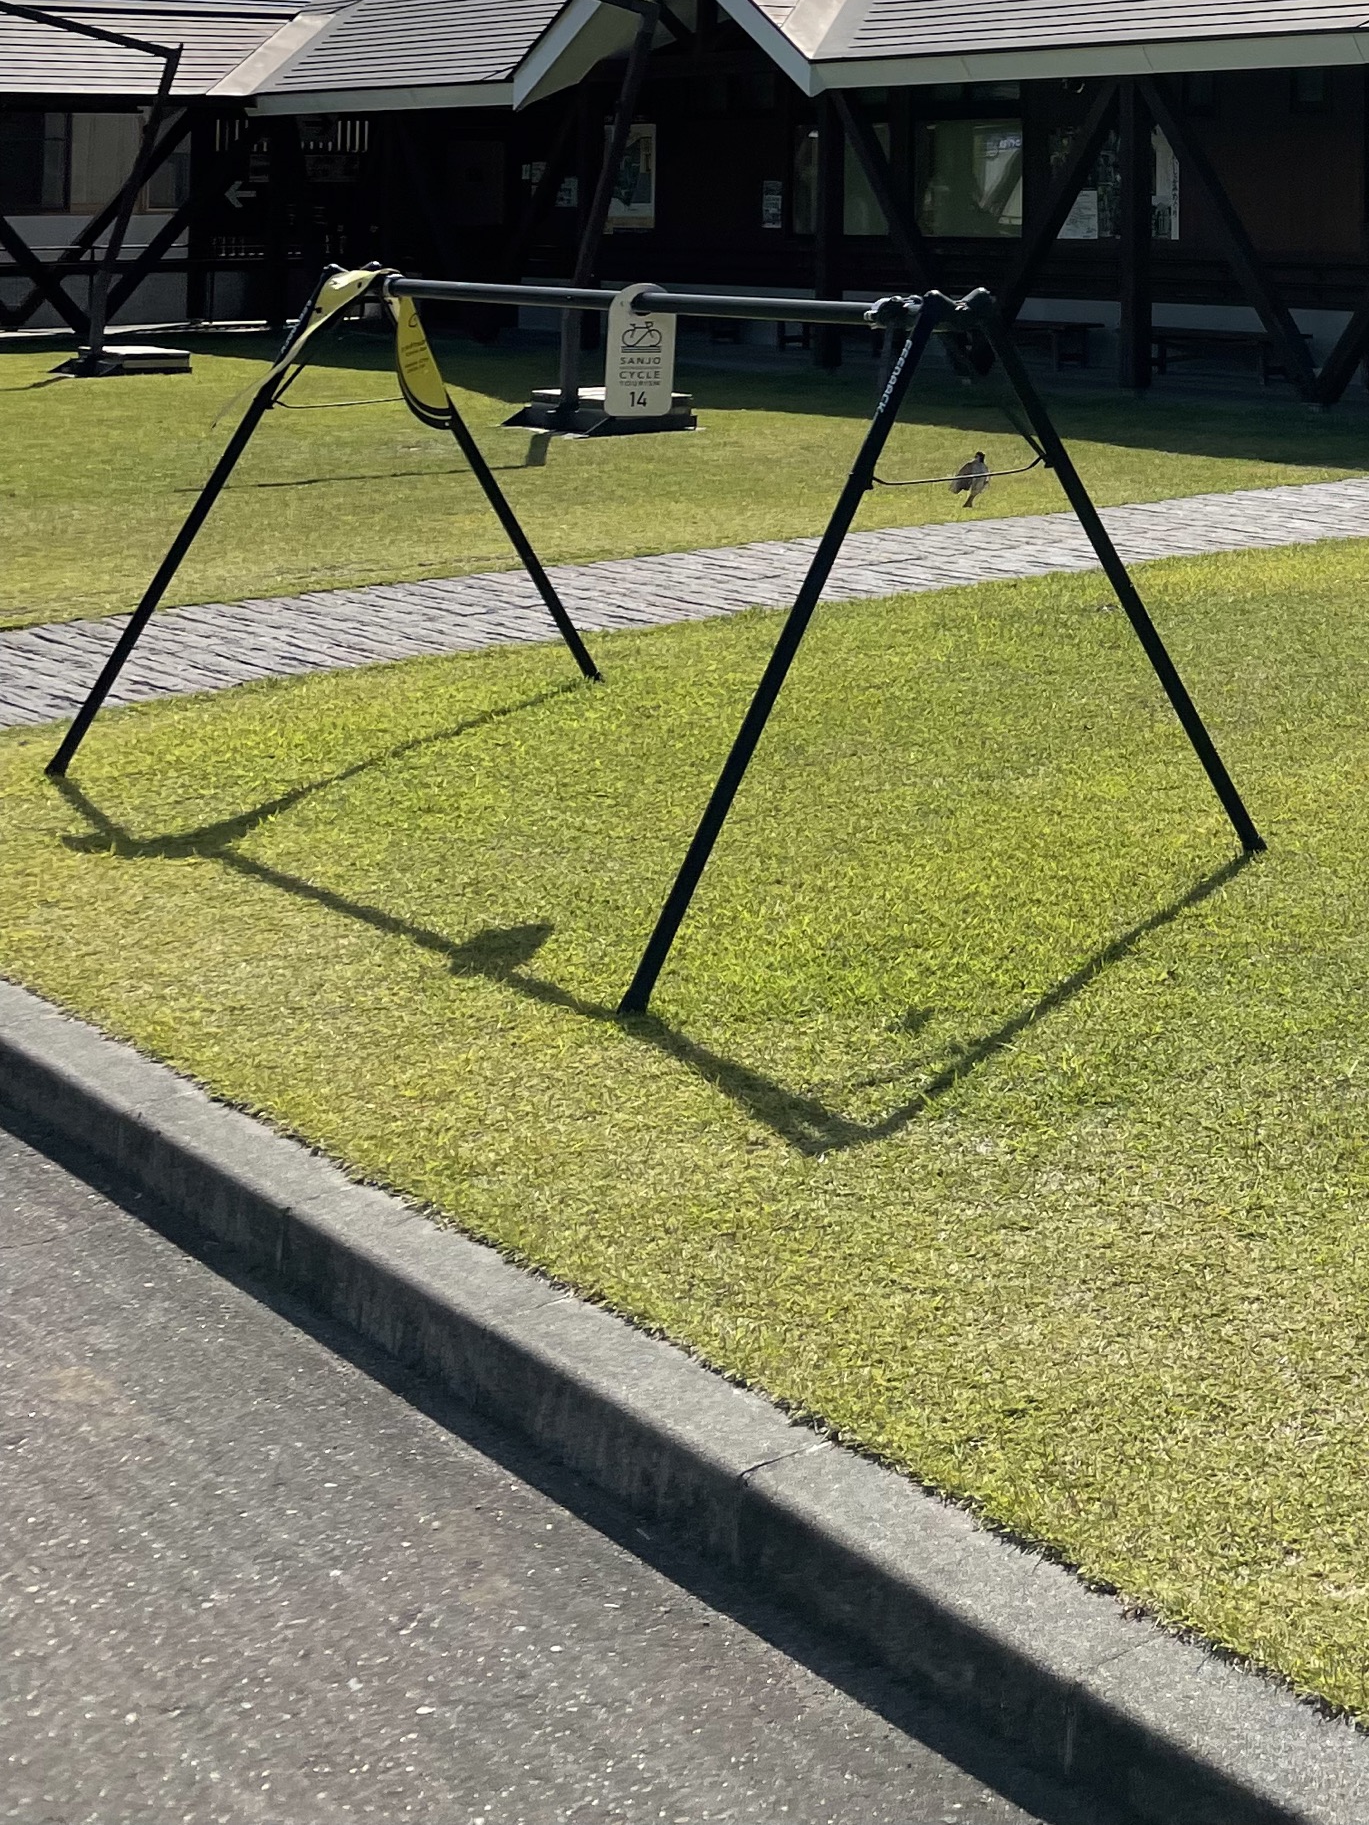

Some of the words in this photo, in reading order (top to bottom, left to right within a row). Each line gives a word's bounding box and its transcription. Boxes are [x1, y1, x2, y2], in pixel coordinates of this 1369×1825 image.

[619, 356, 661, 365] SANJO
[618, 370, 661, 380] CYCLE
[629, 390, 648, 408] 14
